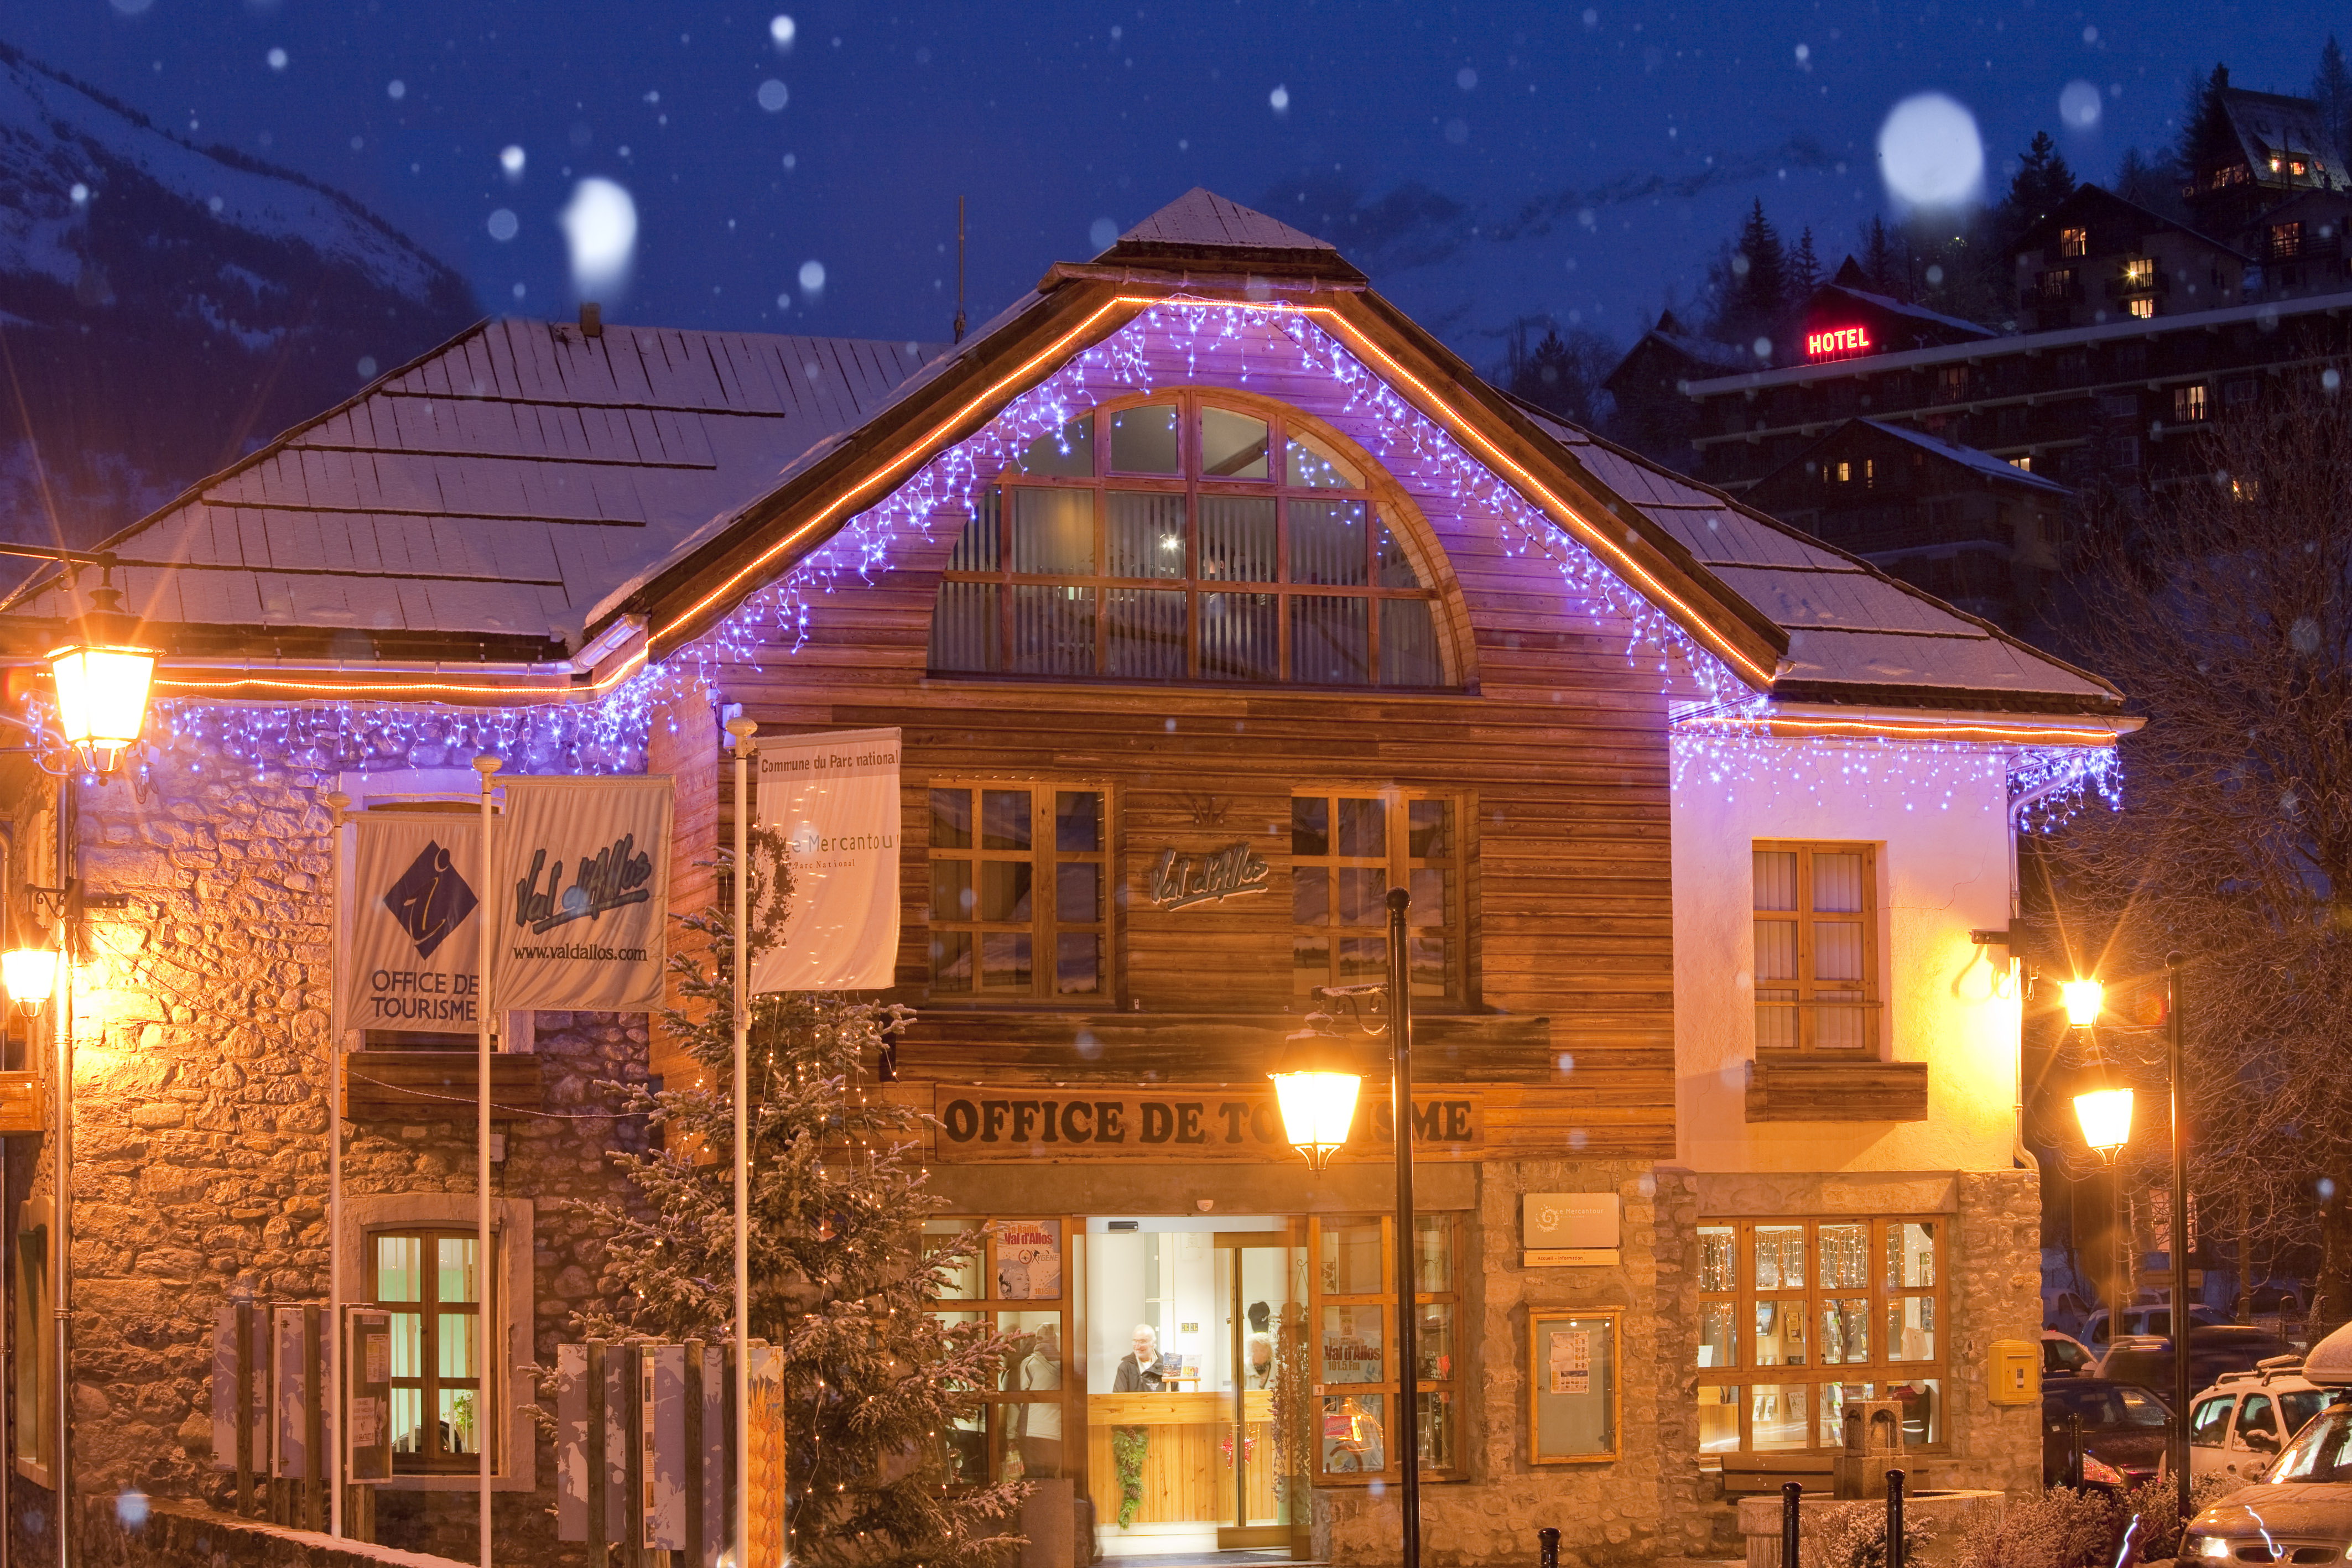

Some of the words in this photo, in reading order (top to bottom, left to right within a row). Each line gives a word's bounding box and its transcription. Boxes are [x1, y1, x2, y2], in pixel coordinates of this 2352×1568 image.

[1809, 328, 1869, 355] HOTEL
[762, 753, 810, 773] Commune
[814, 756, 826, 769] du
[830, 754, 852, 768] Parc
[856, 749, 898, 767] national
[809, 833, 899, 852] Mercantou
[816, 858, 855, 868] National
[1151, 847, 1190, 905] Val
[1190, 841, 1269, 903] d'Allos
[517, 848, 563, 928] Val
[561, 833, 652, 921] d'Allos
[513, 942, 648, 961] www.valdallos.com
[372, 970, 446, 994] OFFICE
[453, 974, 480, 995] DE
[371, 997, 477, 1022] TOURISME
[944, 1098, 1126, 1143] OFFICE
[1139, 1102, 1206, 1144] DE
[1219, 1100, 1472, 1144] TOISME
[1004, 1233, 1020, 1245] Val
[1021, 1233, 1053, 1244] d'Allos
[1018, 1225, 1039, 1233] Radio
[1324, 1345, 1343, 1361] Val
[1344, 1345, 1381, 1361] d'Allos
[1328, 1361, 1347, 1371] 101.5
[1349, 1361, 1360, 1371] Fm
